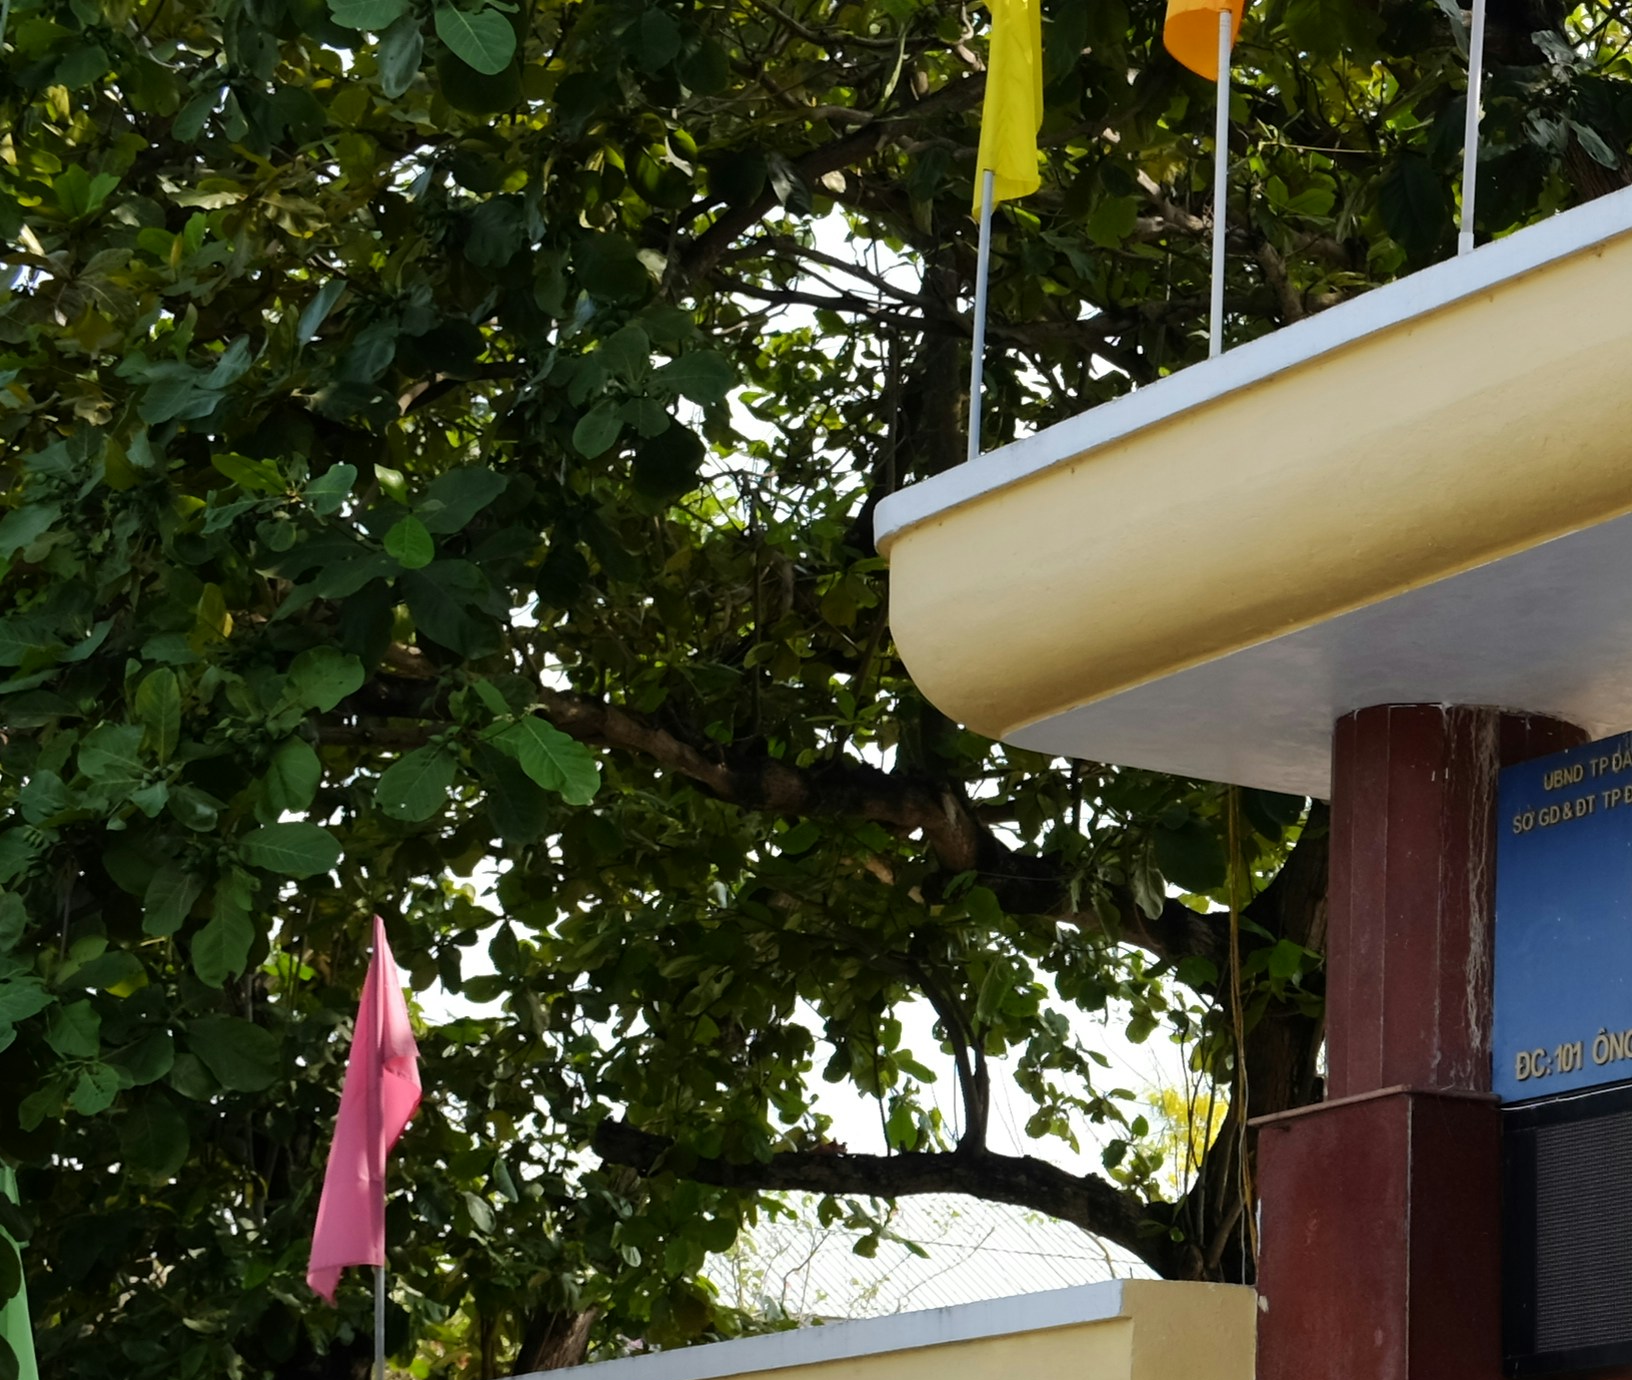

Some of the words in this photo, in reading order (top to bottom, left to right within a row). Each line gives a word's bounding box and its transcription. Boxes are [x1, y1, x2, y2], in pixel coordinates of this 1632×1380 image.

[1544, 764, 1584, 791] UBND
[1589, 757, 1609, 777] TP
[1602, 788, 1622, 809] TP
